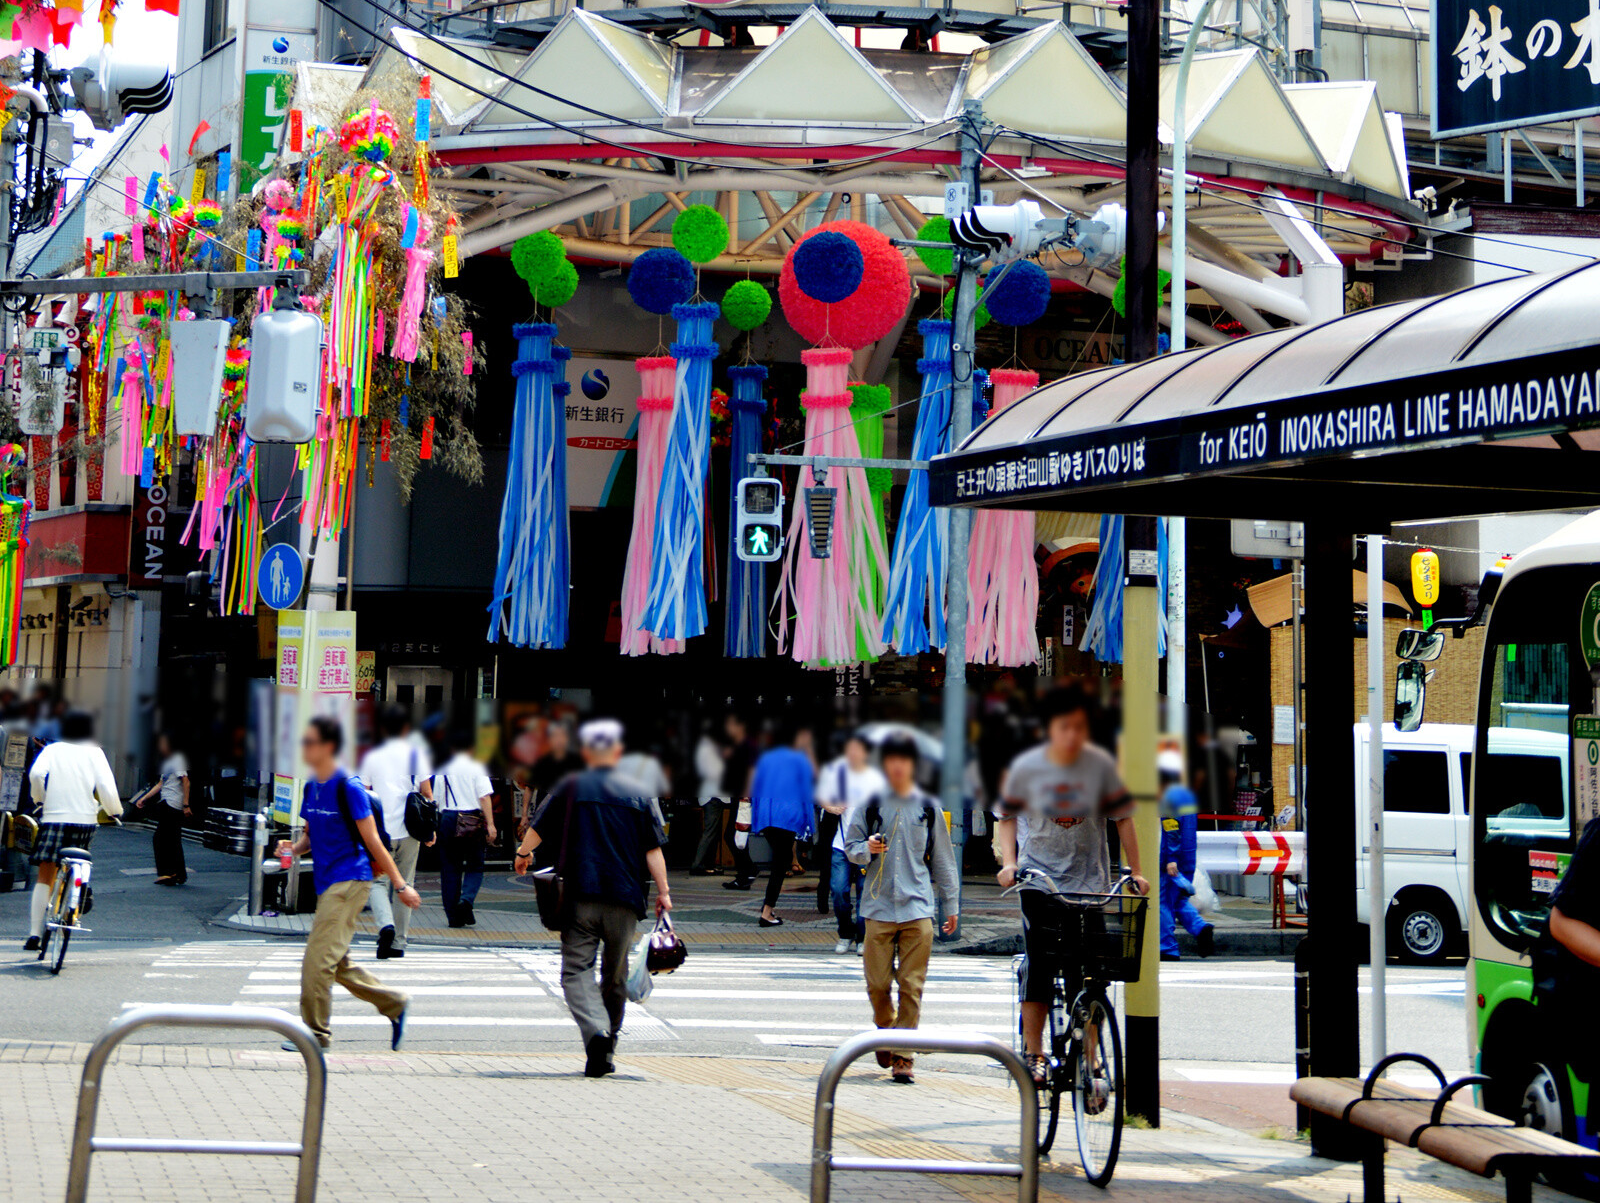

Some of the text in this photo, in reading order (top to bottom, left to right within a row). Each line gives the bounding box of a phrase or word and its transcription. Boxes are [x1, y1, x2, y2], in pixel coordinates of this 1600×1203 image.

[262, 55, 297, 66] 新生銀行
[445, 239, 456, 276] 七夕まつり
[1034, 337, 1124, 365] OCEAN
[565, 405, 625, 424] 新生銀行
[1200, 431, 1224, 465] for
[1279, 401, 1396, 455] INOKASHIRA
[1403, 391, 1451, 438] LINE
[579, 438, 631, 449] カードローン
[956, 436, 1146, 498] 京王井の頭線浜田山駅ゆきバスのりば
[144, 484, 167, 580] OCEAN
[1421, 557, 1433, 599] 七夕まつり
[282, 649, 298, 666] 自転車
[324, 650, 347, 667] 自転車
[319, 667, 350, 686] 走行禁止
